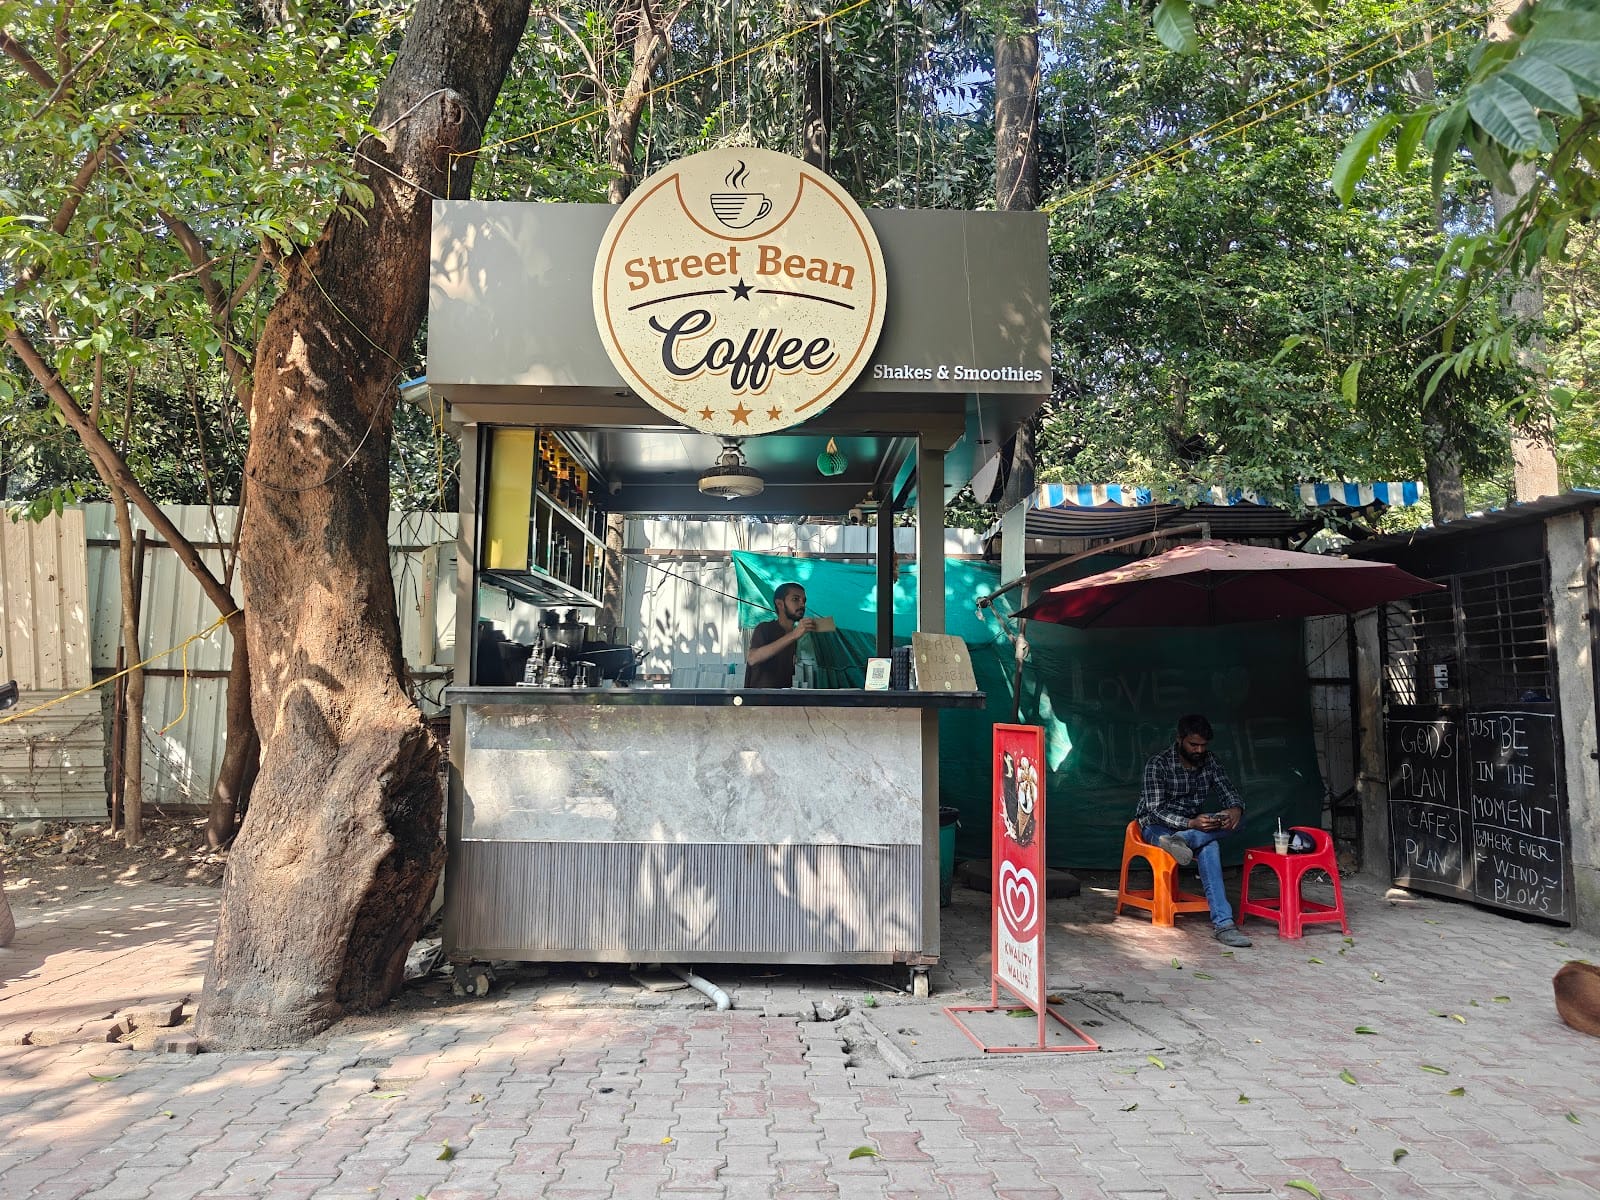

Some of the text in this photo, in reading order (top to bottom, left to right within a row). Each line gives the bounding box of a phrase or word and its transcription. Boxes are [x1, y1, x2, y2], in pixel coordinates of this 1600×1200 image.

[624, 244, 856, 292] Street Bean
[648, 309, 838, 393] Coffee
[873, 364, 1043, 382] Shakes & Smoothies
[1469, 715, 1529, 750] JUST BE
[1401, 763, 1446, 802] PLAN
[1476, 760, 1535, 786] IN THE
[1472, 794, 1552, 836] MOMENT
[1405, 838, 1447, 875] PLAN
[1475, 829, 1555, 862] WHERE EVER
[1493, 855, 1538, 886] WIND
[1494, 878, 1551, 911] BLOW'S
[1004, 940, 1032, 971] KWALITY
[1006, 961, 1029, 989] WALL'S
